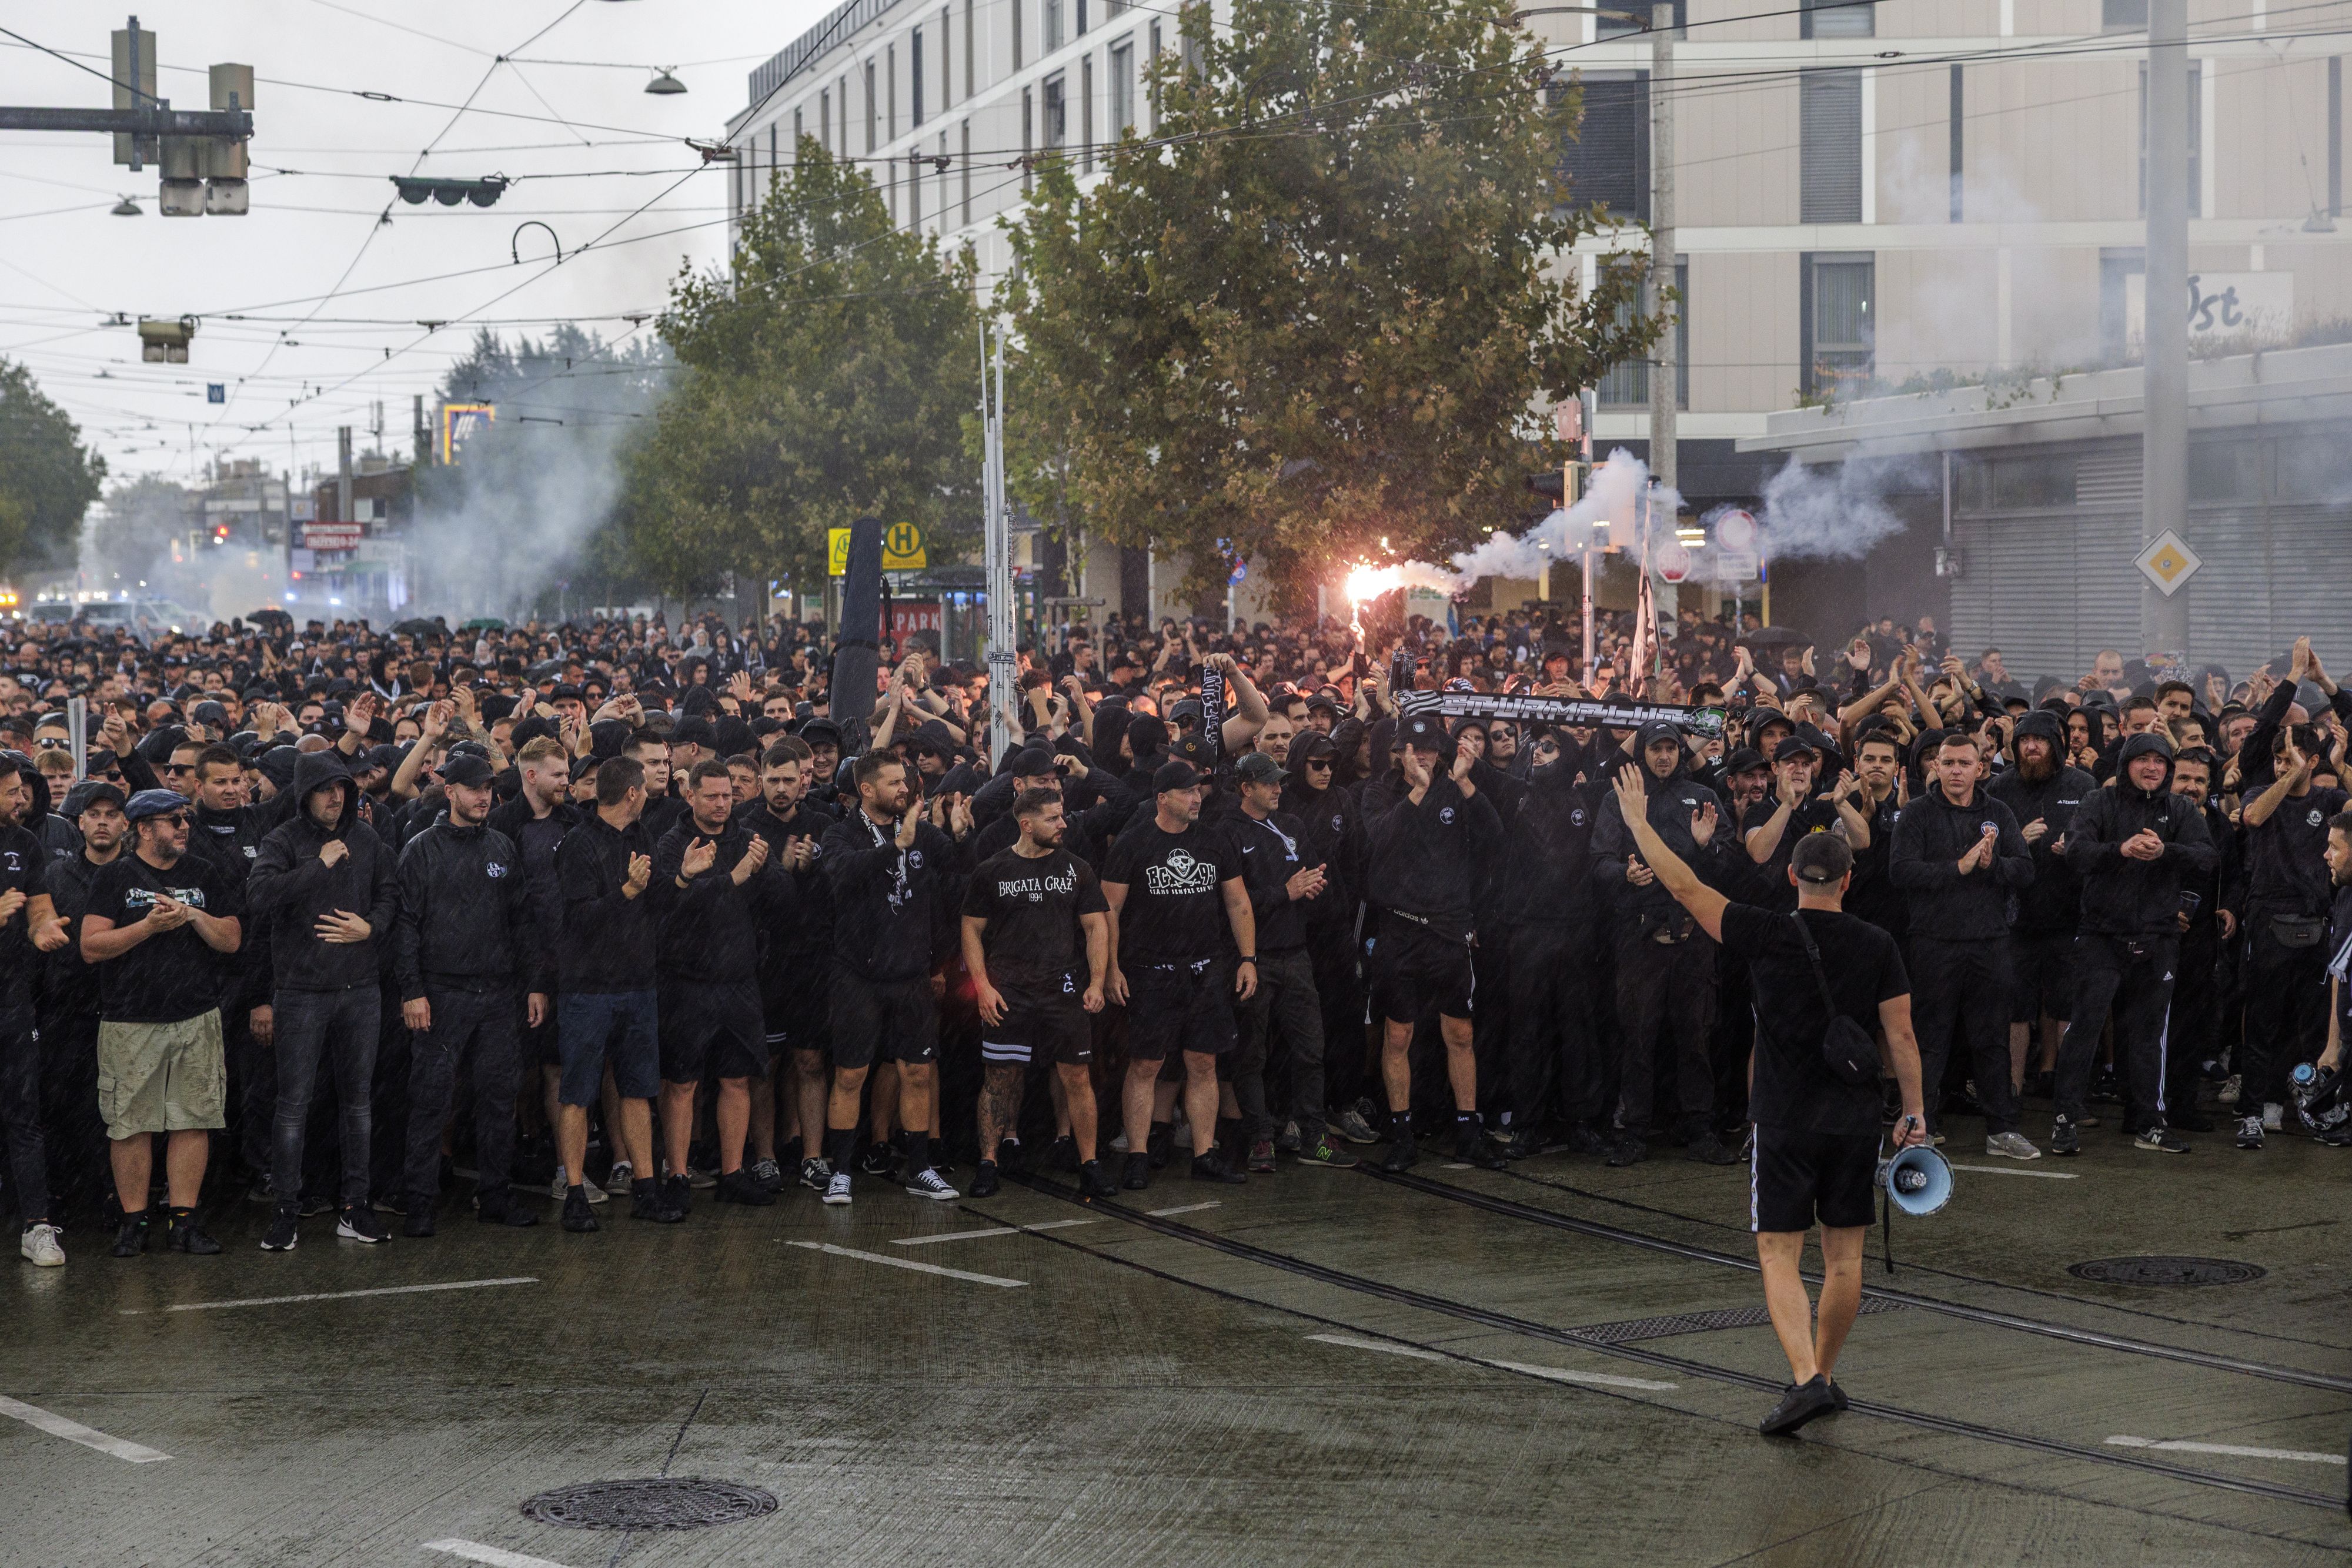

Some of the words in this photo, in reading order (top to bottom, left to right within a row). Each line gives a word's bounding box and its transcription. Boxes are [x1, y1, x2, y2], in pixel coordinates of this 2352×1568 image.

[895, 526, 911, 551] H
[998, 878, 1042, 897] BRIGATA
[1044, 875, 1073, 894] GRAZ
[1146, 865, 1171, 888] BG
[1028, 892, 1043, 902] 1994
